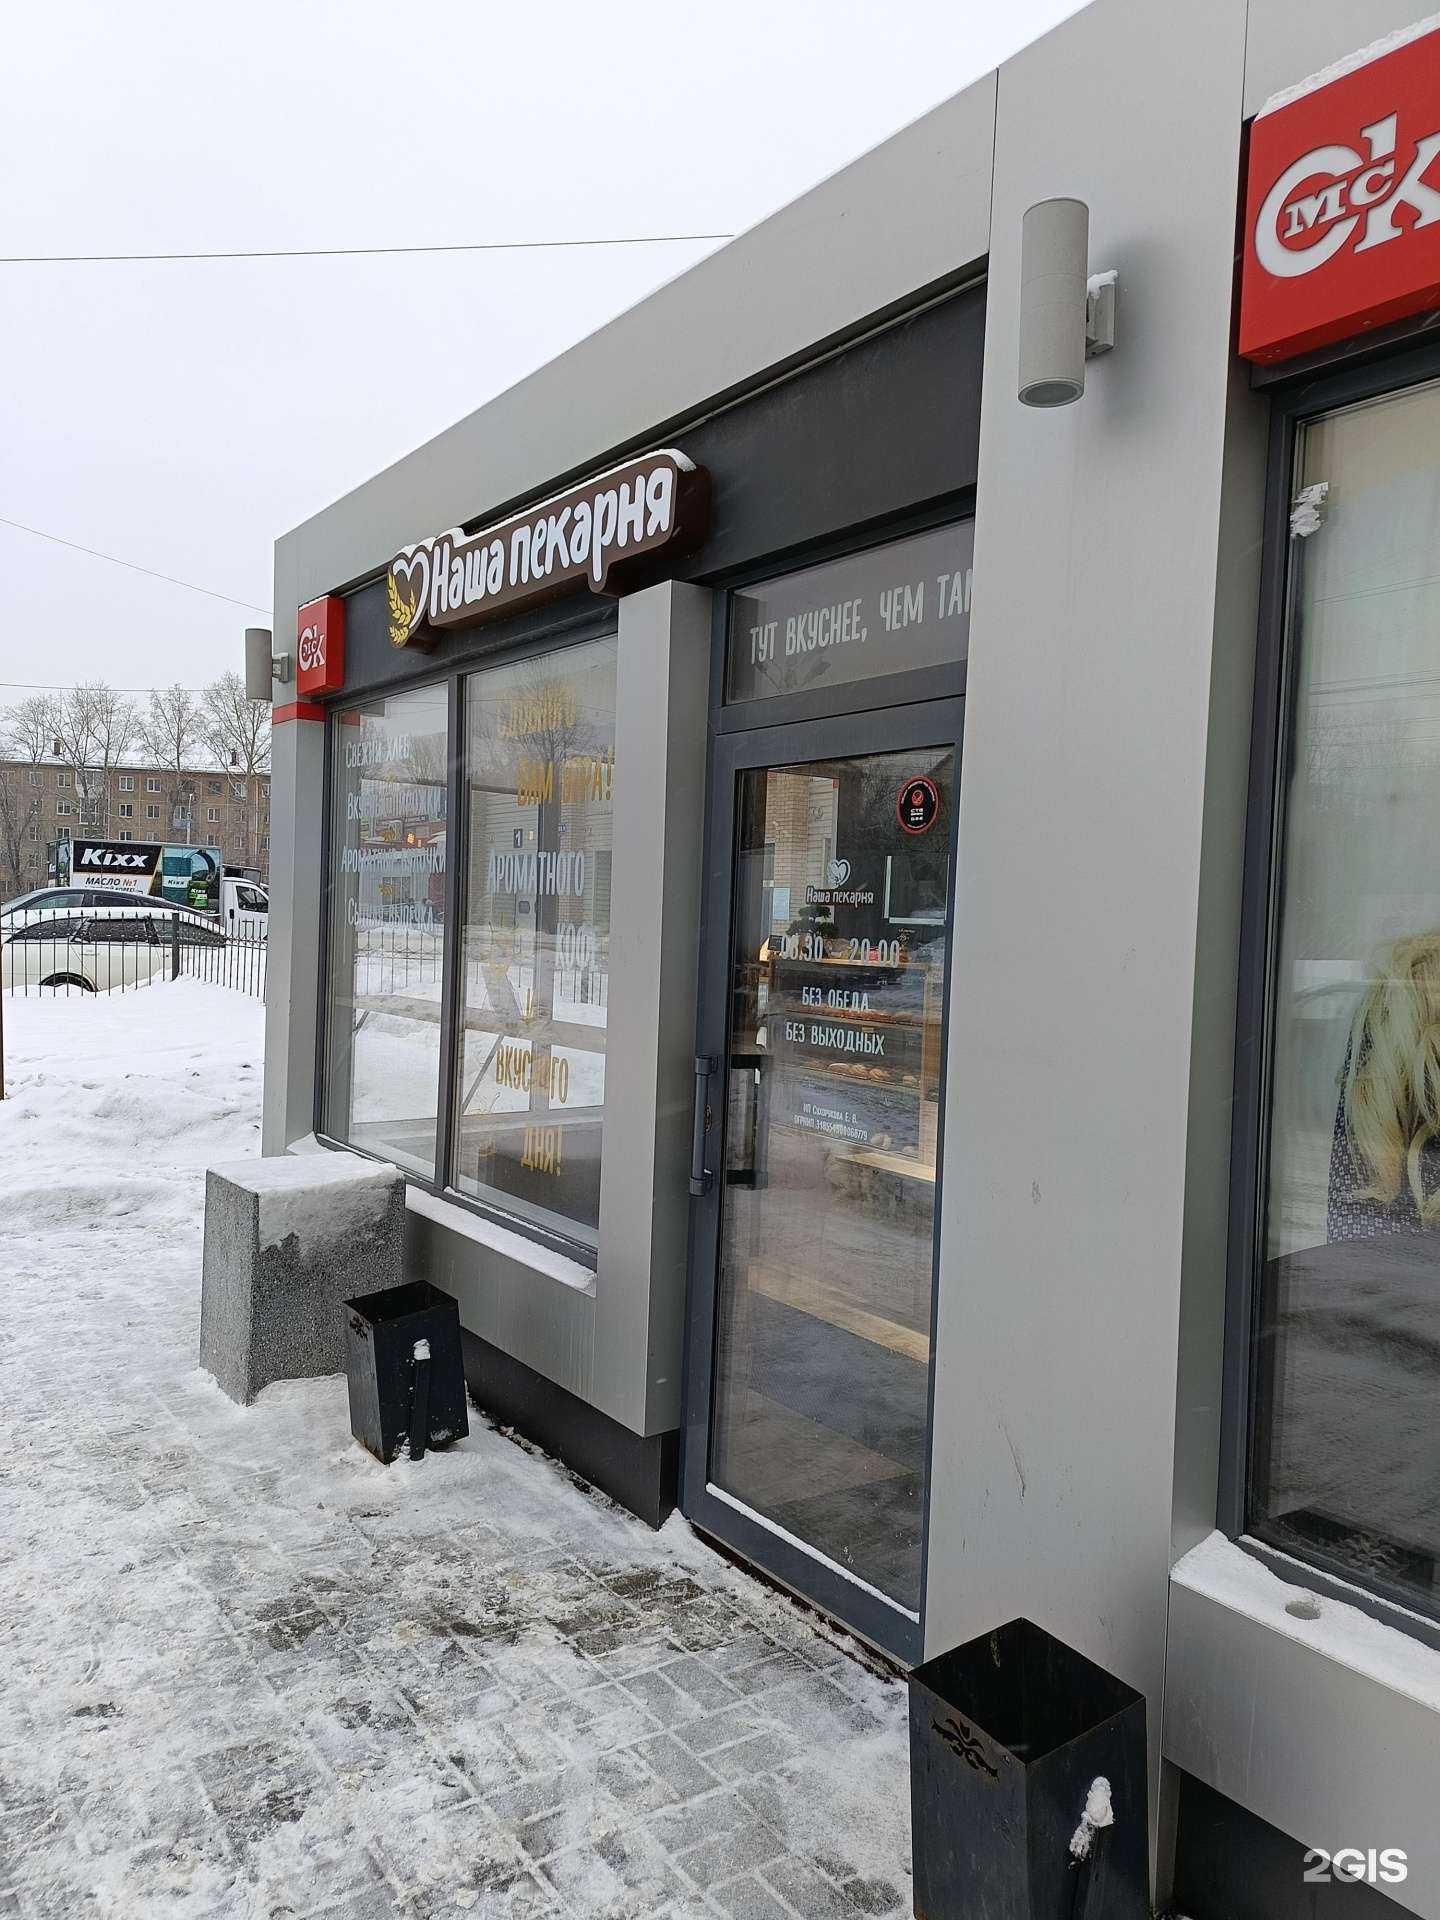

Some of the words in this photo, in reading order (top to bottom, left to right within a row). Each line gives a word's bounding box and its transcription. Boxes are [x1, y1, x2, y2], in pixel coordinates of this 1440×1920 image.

[429, 538, 504, 619] Наша
[509, 467, 673, 583] пекарня
[750, 621, 778, 665] ТУТ
[785, 598, 868, 656] ВКУСНЕЕ,
[880, 581, 925, 632] ЧЕМ
[80, 848, 150, 867] Kixx
[487, 848, 585, 897] АРОМАТНОГО
[85, 877, 121, 886] МАСЛО
[806, 885, 831, 903] Наша
[833, 889, 874, 908] пекарня
[555, 921, 602, 972] КОФ
[802, 986, 822, 1007] БЕЗ
[827, 989, 869, 1012] ОБЕДА
[785, 1021, 805, 1043] БЕЗ
[811, 1025, 885, 1056] ВЫХОДНЫХ
[496, 1044, 569, 1104] ВКУСГО
